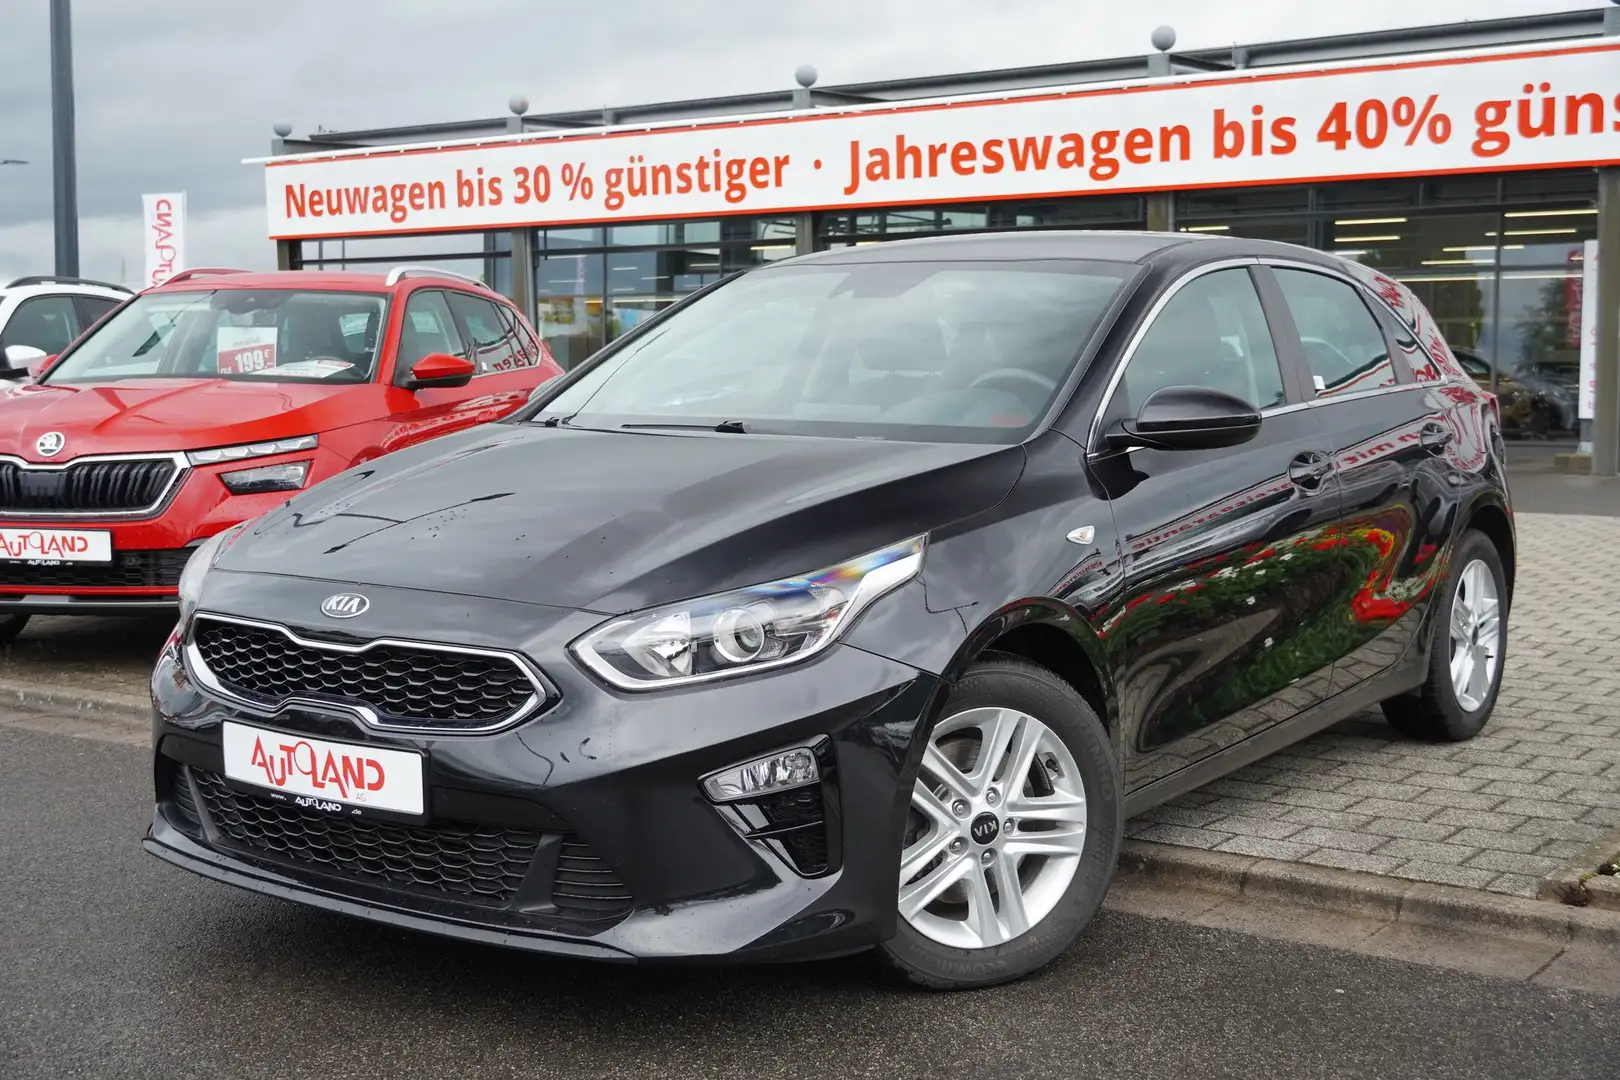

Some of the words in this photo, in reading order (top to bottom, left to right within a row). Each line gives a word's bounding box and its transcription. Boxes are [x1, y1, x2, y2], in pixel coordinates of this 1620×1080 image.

[284, 181, 446, 224] Neuwagen
[456, 168, 503, 208] bis
[513, 166, 551, 205] 30
[560, 163, 594, 200] %
[604, 149, 791, 211] günstiger
[844, 125, 1191, 195] Jahreswagen
[1213, 105, 1297, 159] bis
[1317, 94, 1452, 151] 40%
[1471, 82, 1620, 158] gün
[325, 595, 361, 613] KIA
[251, 735, 386, 799] AUTOLAND
[294, 796, 342, 812] AUTOLAND
[973, 819, 998, 837] KIA
